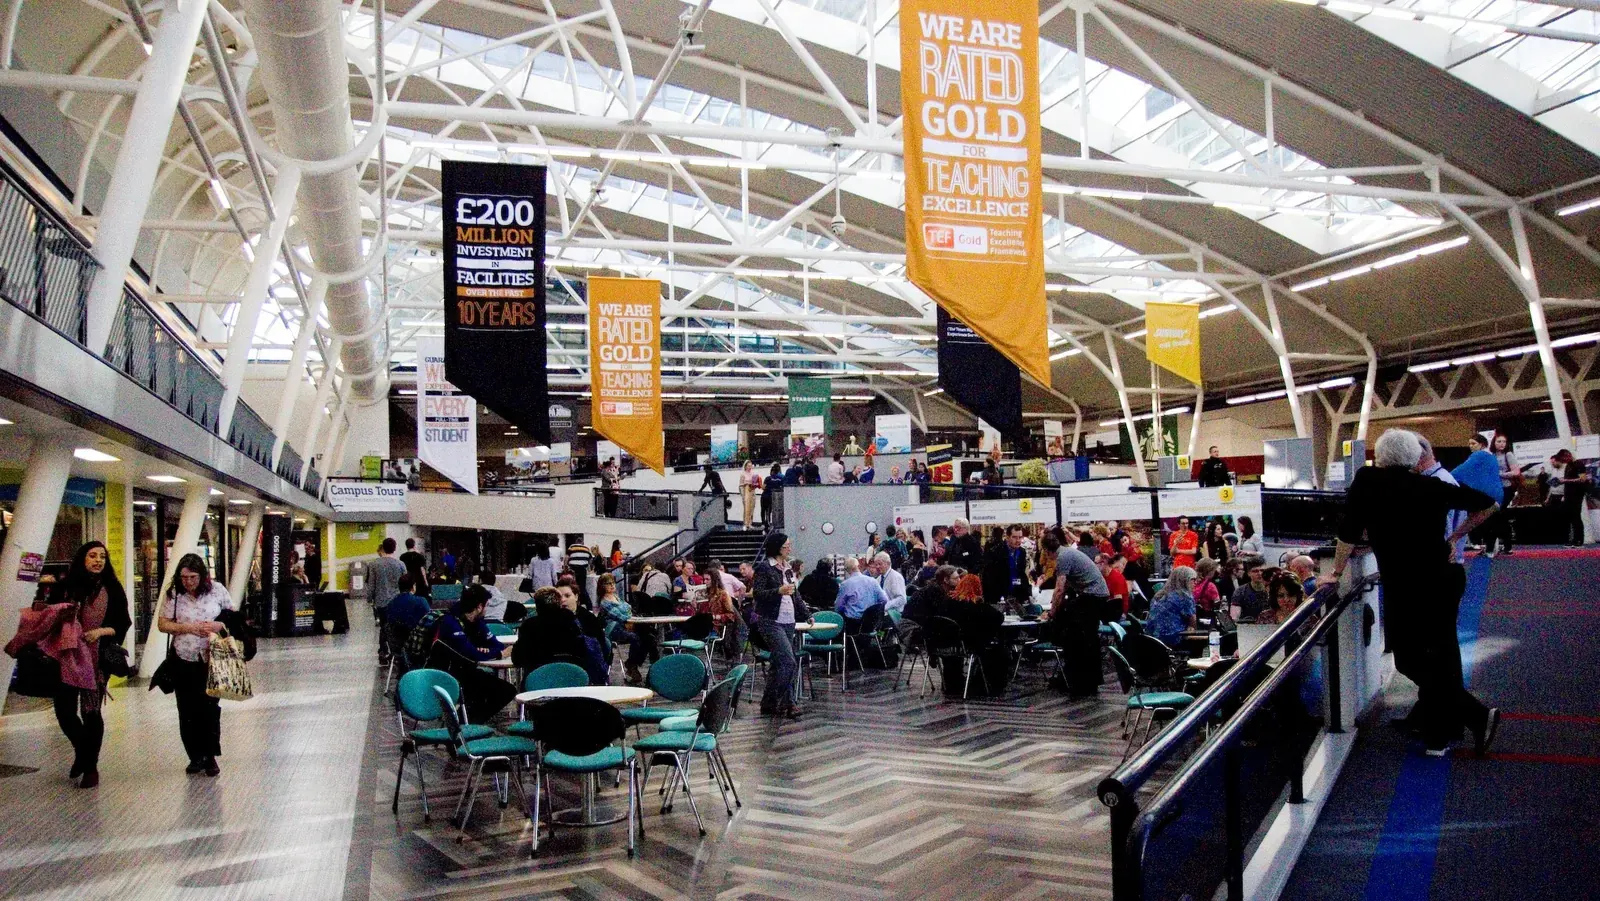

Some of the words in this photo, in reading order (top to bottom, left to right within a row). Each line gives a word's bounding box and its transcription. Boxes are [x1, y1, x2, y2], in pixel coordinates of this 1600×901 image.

[918, 11, 964, 42] WE
[967, 20, 1022, 49] ARE
[920, 40, 1024, 105] RATED
[922, 100, 1026, 143] GOLD
[962, 145, 987, 157] FOR
[922, 157, 1029, 198] TEACHING
[456, 198, 534, 226] £200
[922, 195, 1029, 217] EXCELLENCE
[456, 226, 534, 244] MILLION
[928, 229, 951, 244] TEF
[958, 234, 981, 246] Gold
[990, 228, 1023, 238] Teaching
[456, 244, 534, 257] INVESTMENT
[456, 270, 534, 286] FACILITIES
[466, 288, 487, 296] OVER
[488, 289, 501, 297] THE
[504, 289, 524, 297] PAST
[598, 303, 622, 316] WE
[624, 304, 653, 317] ARE
[598, 316, 653, 344] RATED
[600, 344, 653, 362] GOLD
[600, 371, 653, 388] TEACHING
[600, 388, 653, 397] EXCELLENCE
[425, 397, 469, 416] EVERY
[424, 428, 469, 442] STUDENT
[331, 484, 374, 498] Campus
[375, 486, 404, 496] Tours
[1223, 490, 1229, 499] 3
